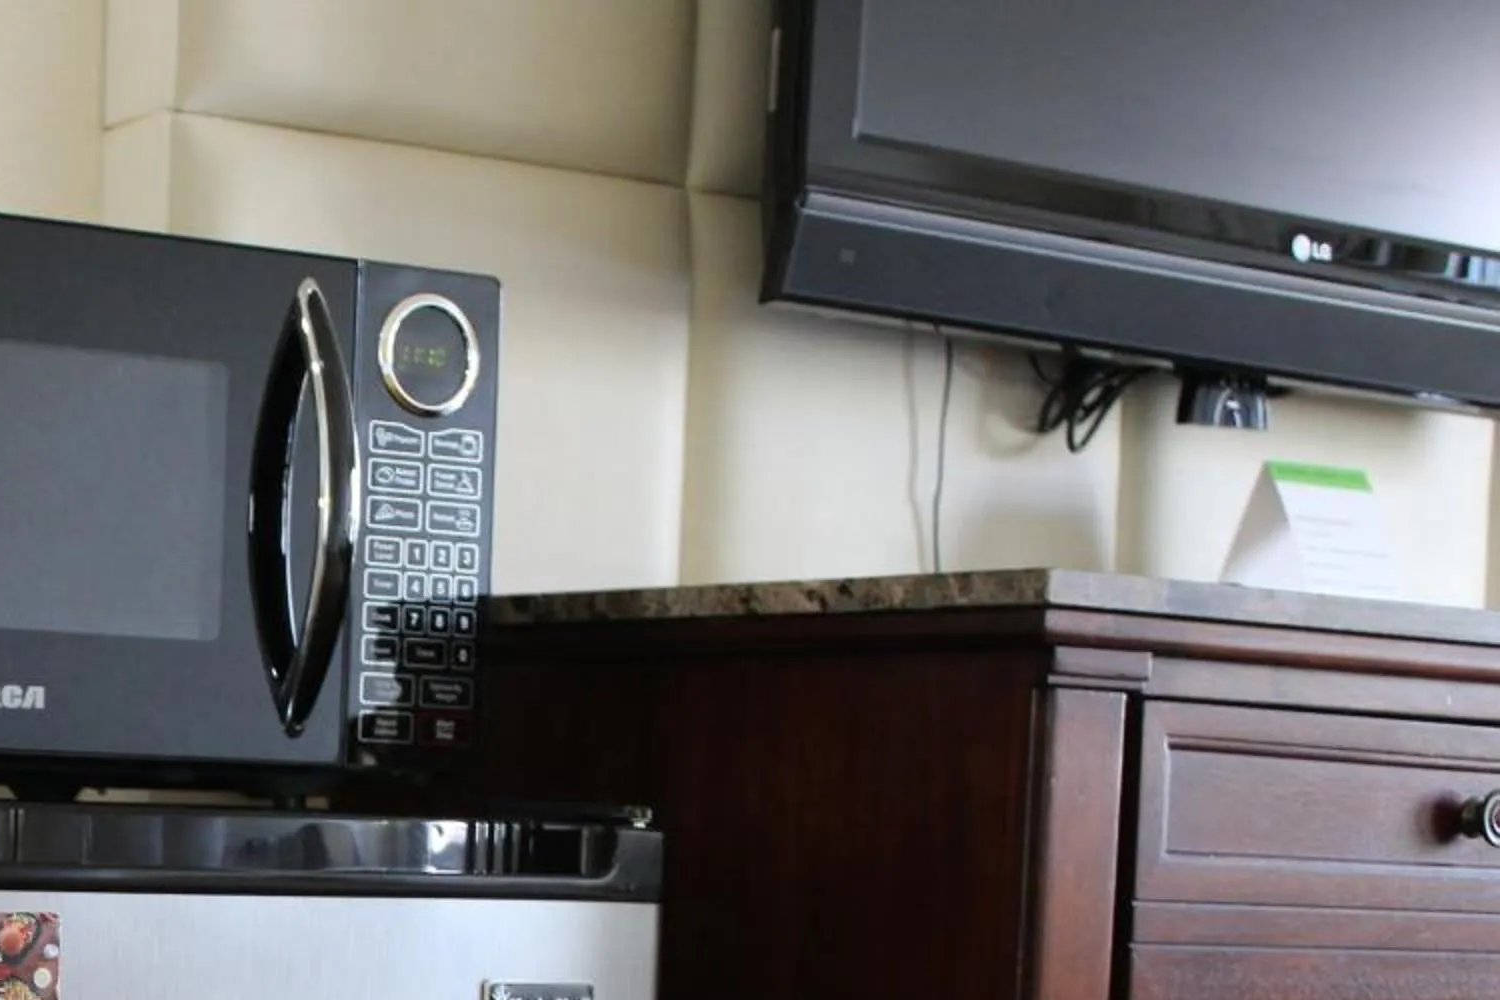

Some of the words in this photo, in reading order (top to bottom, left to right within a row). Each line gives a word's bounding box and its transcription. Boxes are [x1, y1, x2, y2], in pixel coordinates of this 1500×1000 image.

[412, 547, 421, 561] 1
[437, 548, 447, 564] 2
[462, 550, 472, 566] 3
[410, 579, 421, 594] 4
[436, 580, 446, 595] 5
[461, 582, 471, 598] 6
[409, 612, 420, 626] 7
[435, 613, 445, 629] 8
[459, 615, 469, 630] 9
